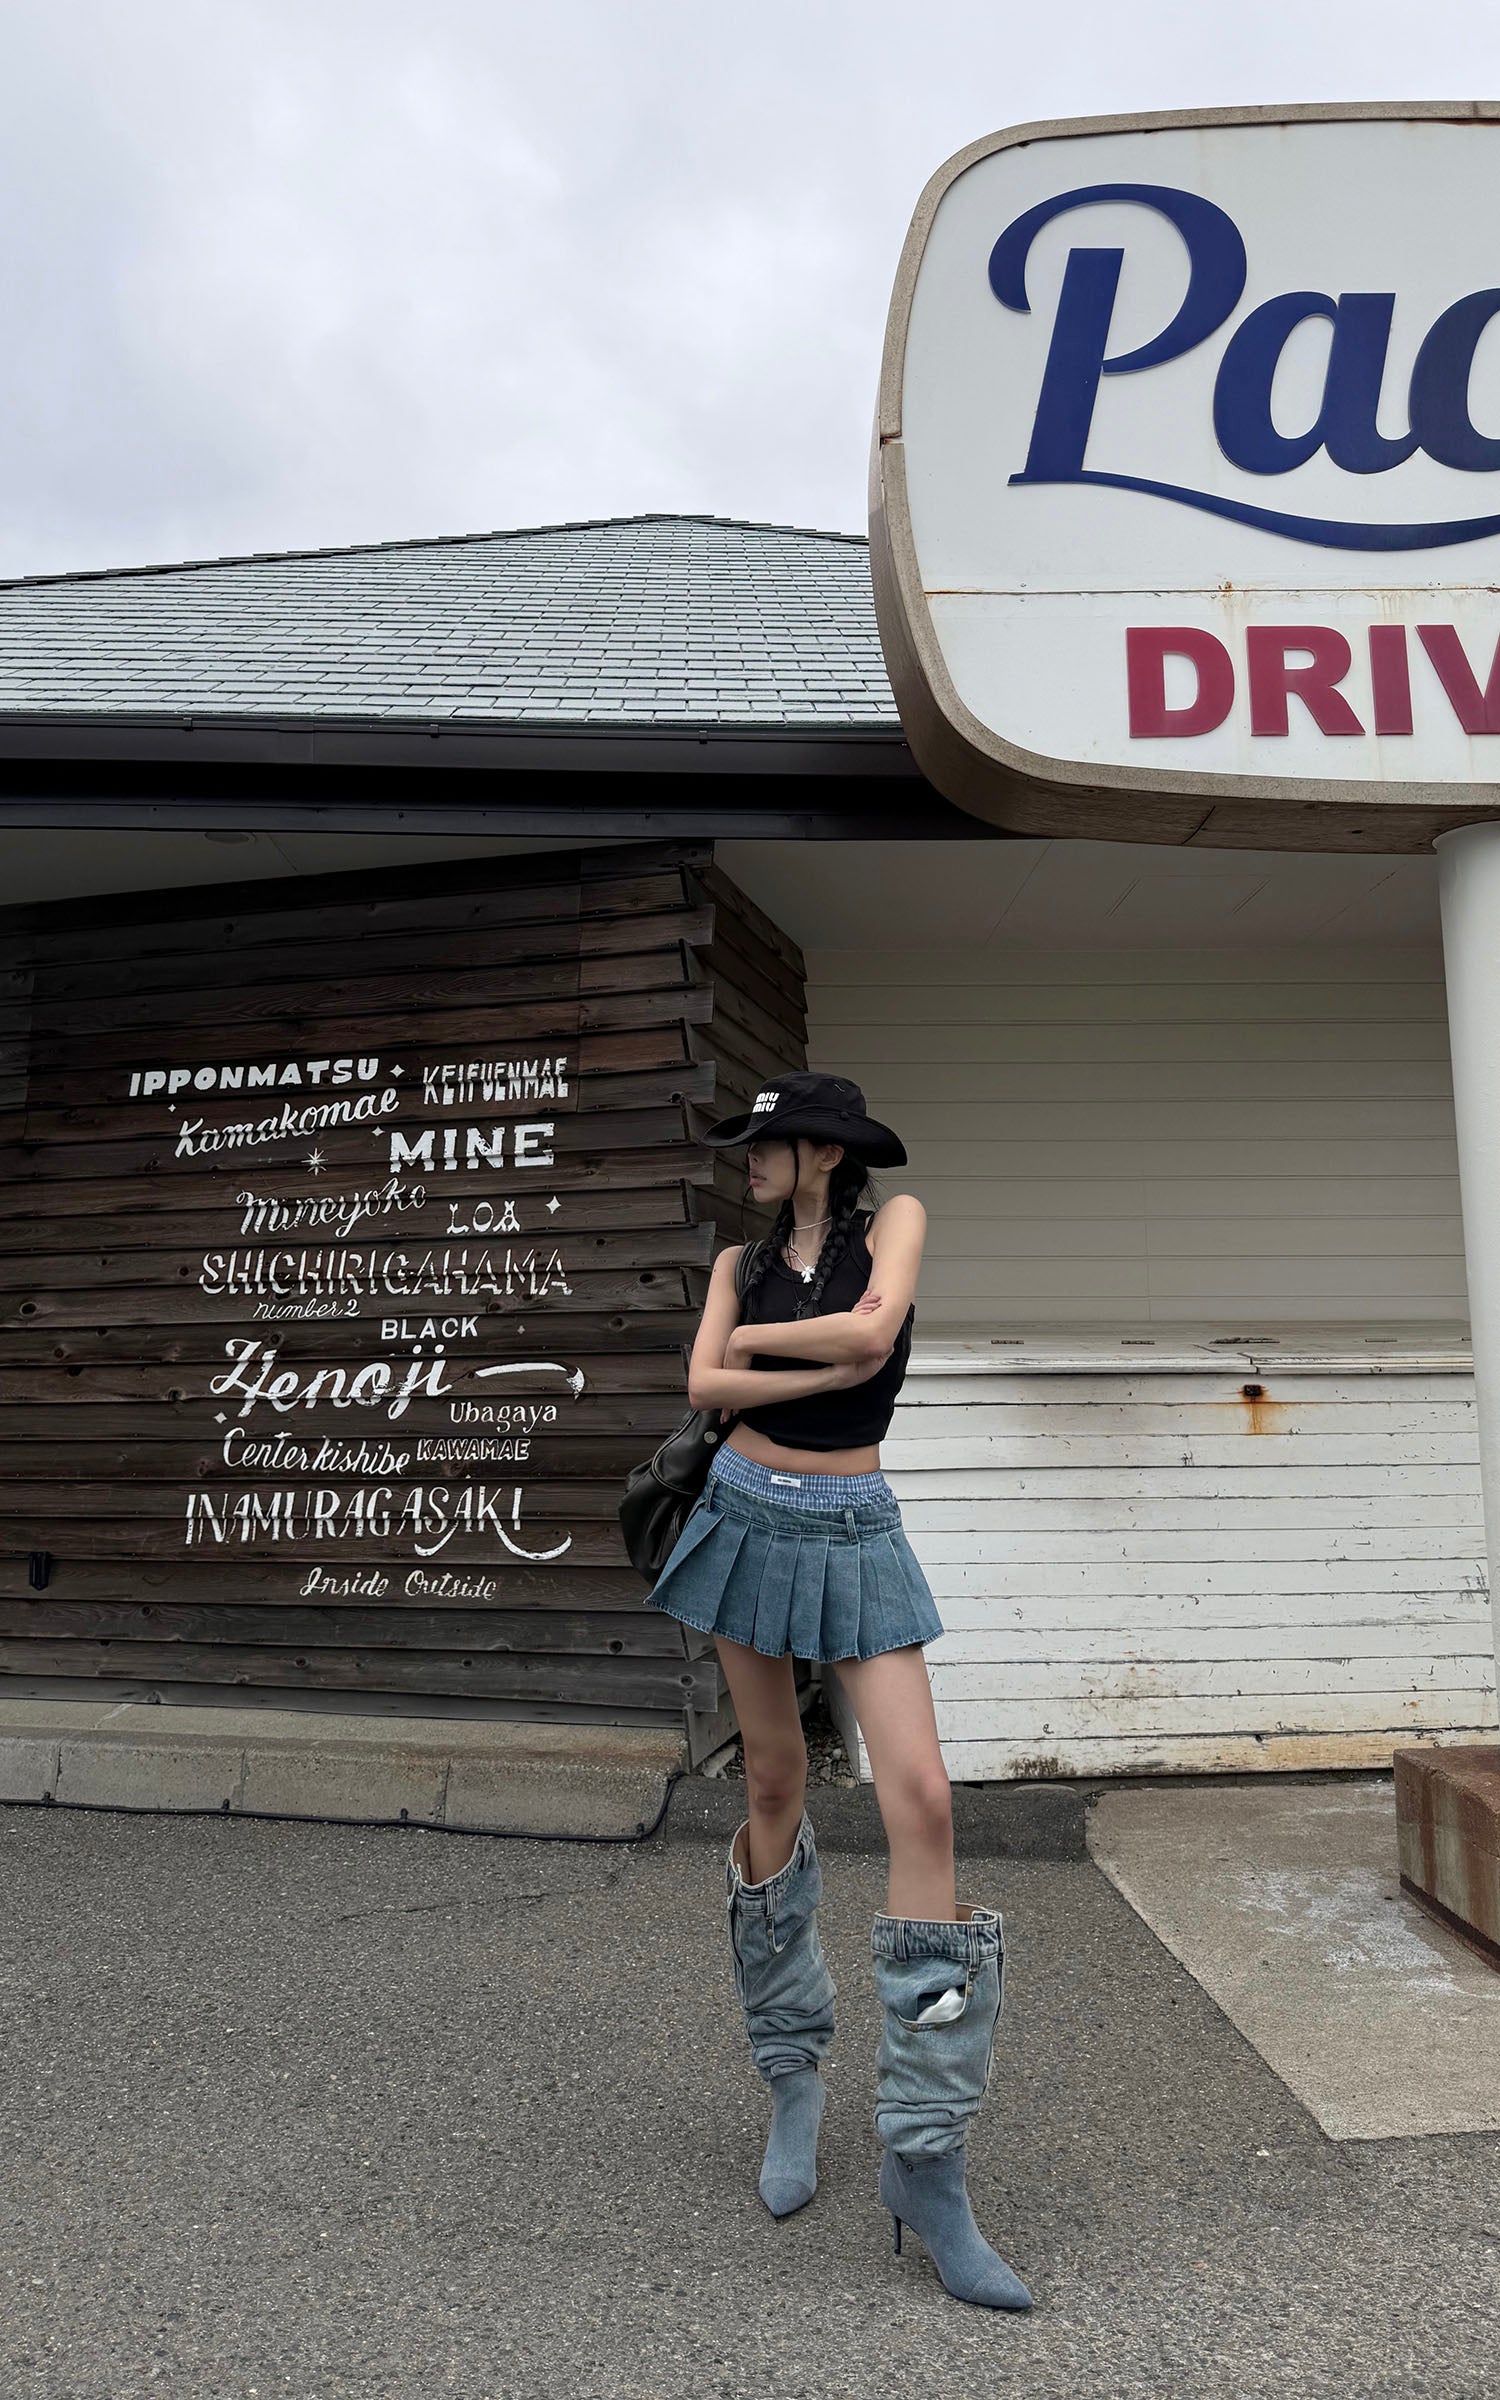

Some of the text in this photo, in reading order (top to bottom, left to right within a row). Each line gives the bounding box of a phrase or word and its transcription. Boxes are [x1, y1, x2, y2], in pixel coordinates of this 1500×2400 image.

[1126, 624, 1500, 738] DRIV
[129, 1059, 378, 1096] IPPONMATSU
[423, 1057, 568, 1105] KEIFUENMAE
[175, 1088, 400, 1158] Kamakomae
[390, 1123, 554, 1173] MINE
[236, 1178, 426, 1237] Mineyoko
[447, 1201, 520, 1233] LOA
[200, 1249, 573, 1295] SHICHIRIGAHAMA
[253, 1299, 360, 1320] number 2
[381, 1316, 478, 1340] BLACK
[209, 1338, 452, 1420] Henoji
[450, 1402, 557, 1433] Ubagaya
[417, 1439, 530, 1461] KAWAMAE
[185, 1485, 572, 1560] INAMURAGASAKI
[300, 1566, 496, 1600] Inside Outside
